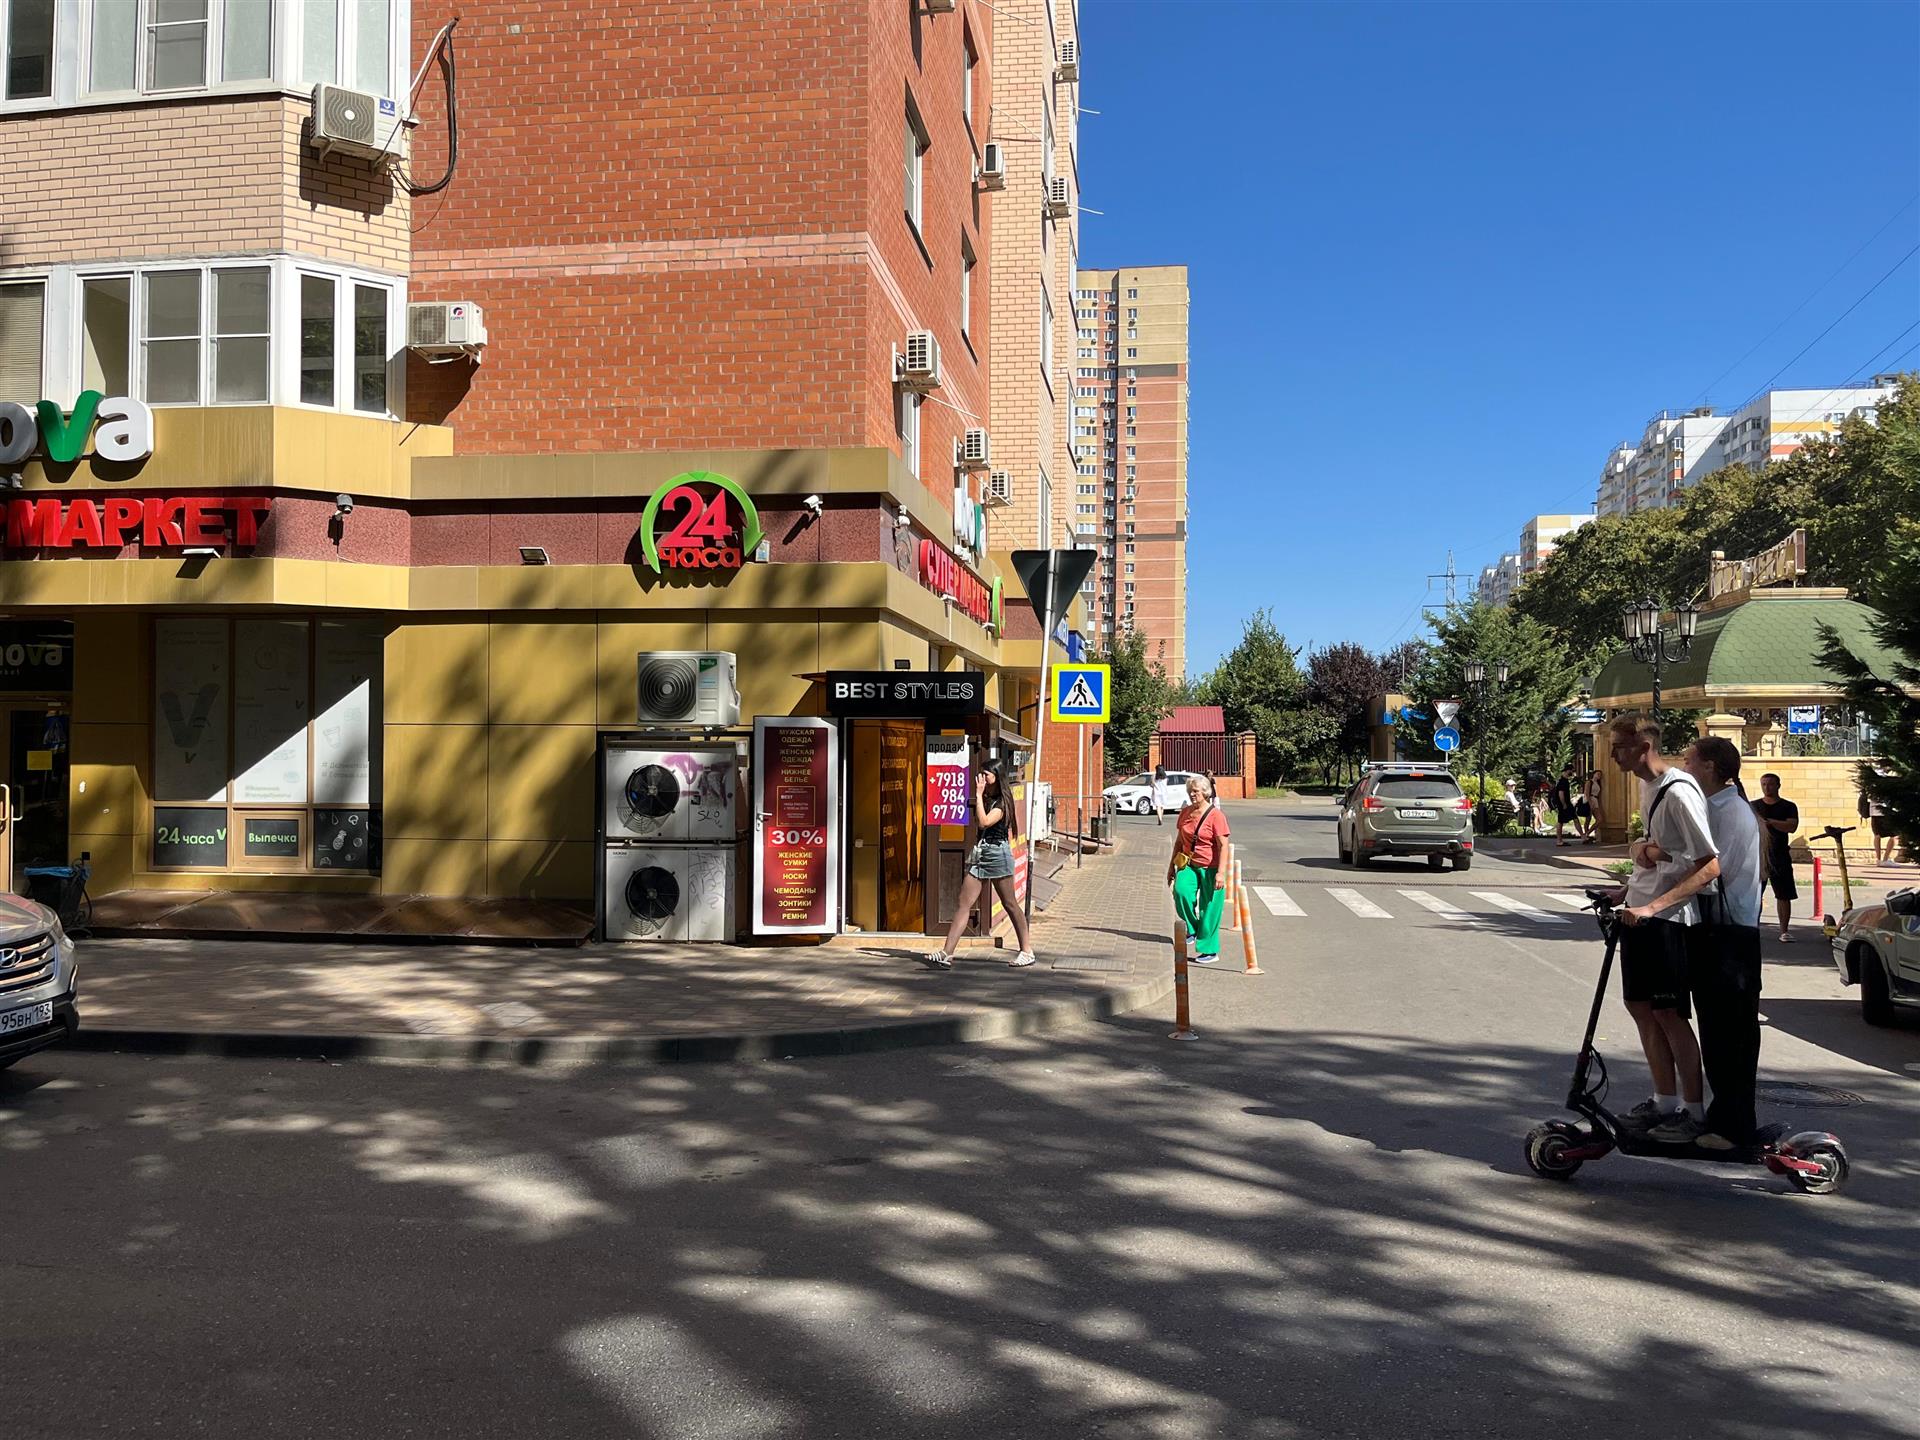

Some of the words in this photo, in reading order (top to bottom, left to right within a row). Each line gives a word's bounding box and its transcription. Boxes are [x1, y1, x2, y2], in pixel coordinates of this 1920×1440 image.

[0, 498, 271, 547] МАРКЕТ
[662, 486, 733, 548] 24
[659, 547, 741, 568] часа
[920, 539, 991, 624] СУПЕРМАРКЕТ
[835, 682, 889, 699] BEST
[894, 682, 974, 699] STYLES
[928, 742, 965, 754] продаю
[930, 772, 965, 787] +7918
[941, 788, 965, 803] 984
[932, 804, 949, 819] 97
[950, 804, 965, 819] 79
[158, 827, 180, 844] 24
[182, 832, 215, 845] часа
[248, 832, 297, 844] Выпечка
[771, 829, 824, 845] 30%
[33, 1004, 50, 1017] 193
